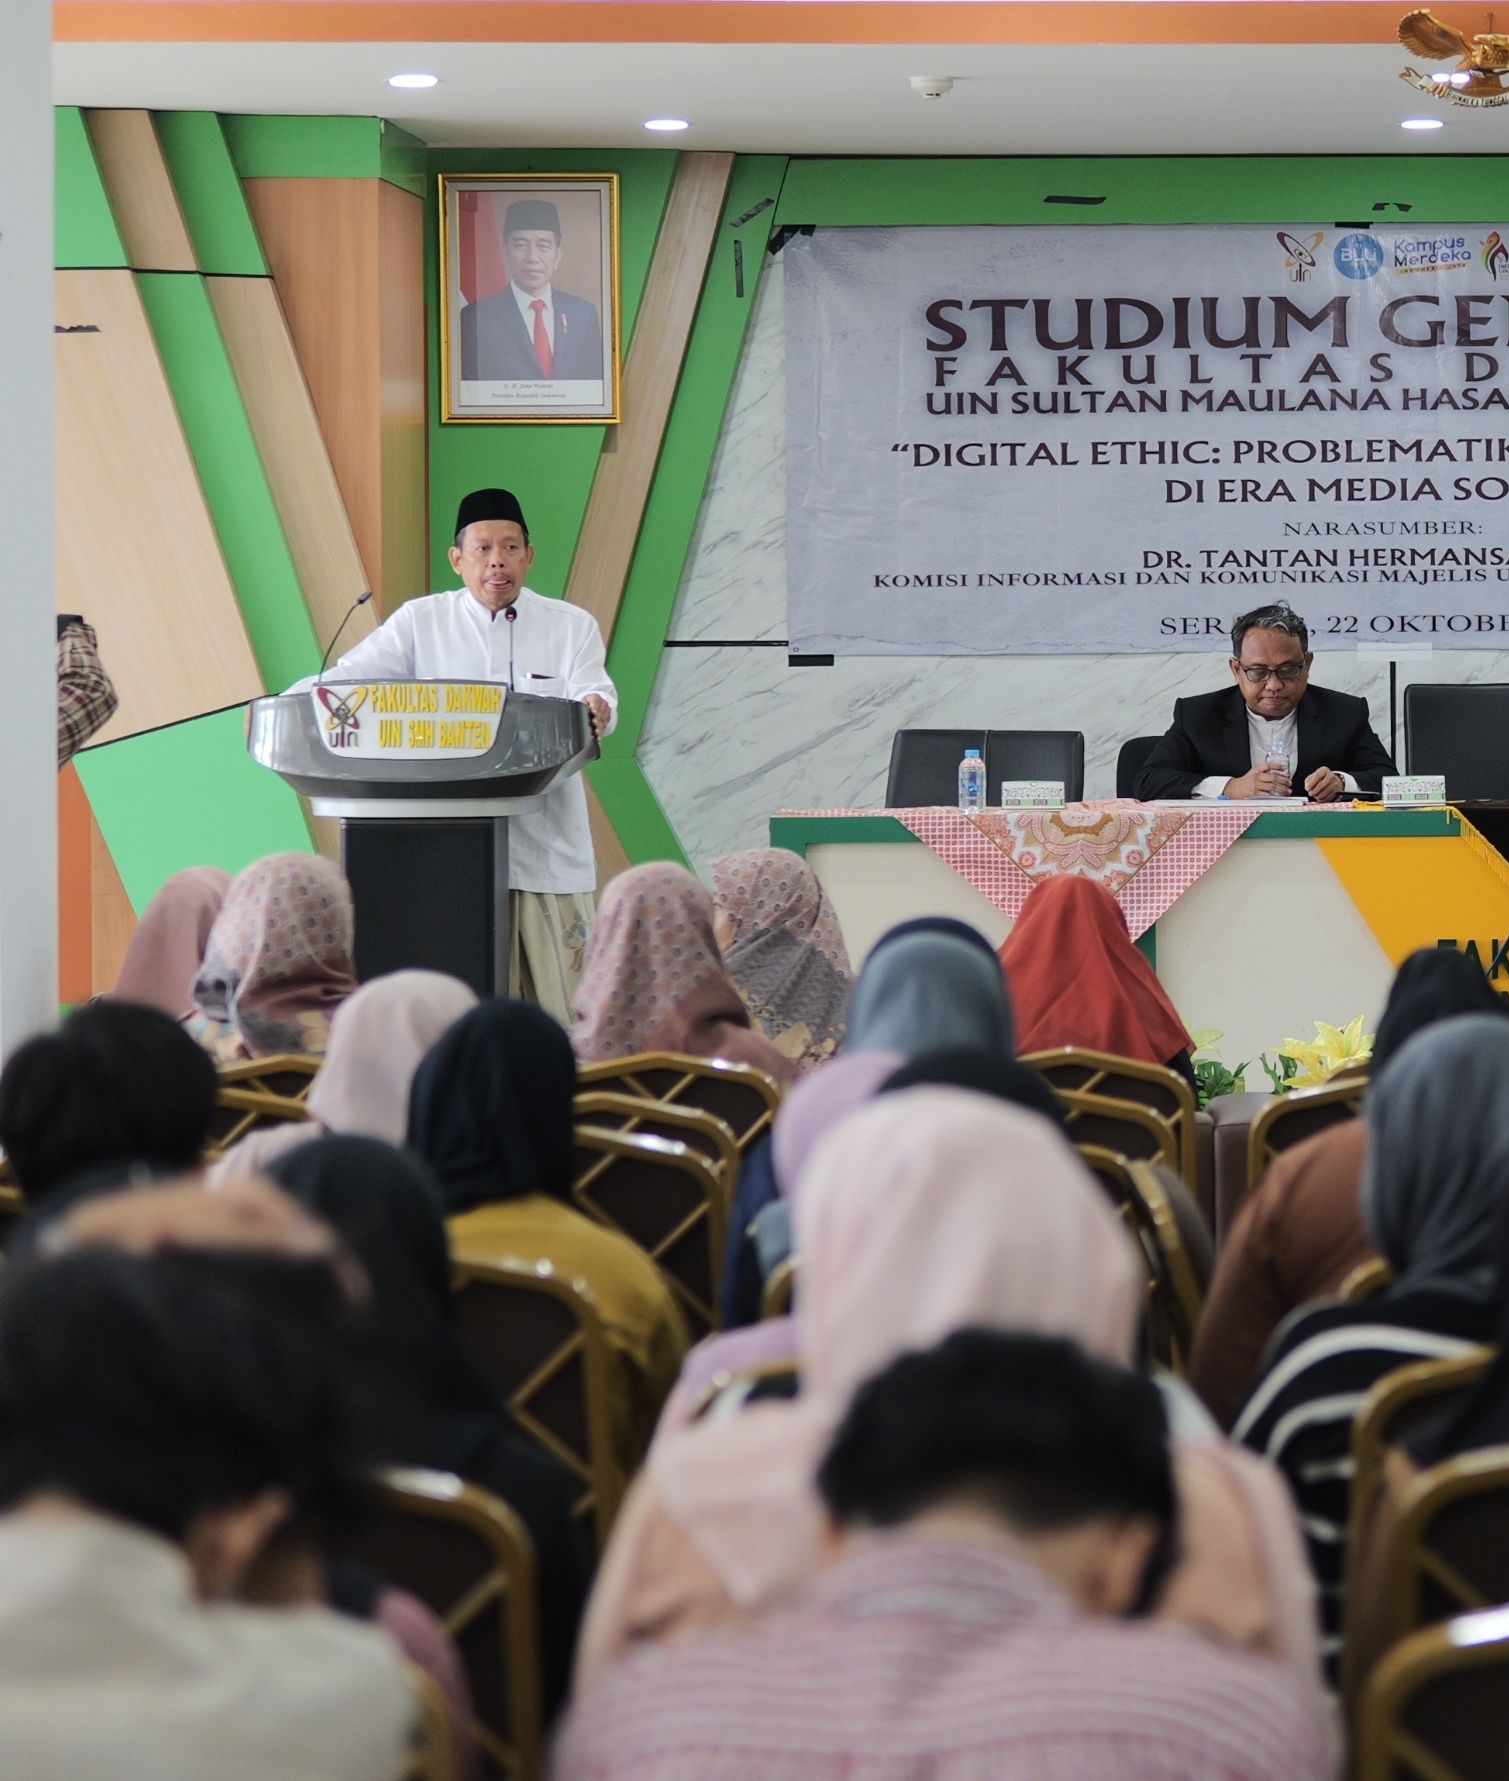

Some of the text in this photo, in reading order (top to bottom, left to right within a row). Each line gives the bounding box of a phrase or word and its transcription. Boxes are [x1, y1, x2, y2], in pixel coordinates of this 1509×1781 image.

[1393, 236, 1466, 254] Kampus
[1394, 249, 1472, 267] Merdeka
[925, 295, 1349, 353] STUDIUM
[933, 352, 1394, 387] FAKULTAS
[925, 391, 999, 416] UIN
[1011, 389, 1169, 415] SULTAN
[1179, 387, 1392, 413] MAULANA
[890, 442, 1080, 468] “DIGITAL
[1090, 440, 1222, 466] ETHIC:
[1164, 478, 1205, 504] DI
[1217, 478, 1298, 503] ERA
[1306, 477, 1444, 503] MEDIA
[1282, 519, 1484, 537] NARASUMBER:
[1142, 549, 1193, 569] DR.
[1198, 548, 1339, 569] TANTAN
[873, 573, 969, 588] KOMISI
[976, 572, 1127, 587] INFORMASI
[1135, 571, 1192, 585] DAN
[1199, 569, 1371, 585] KOMUNIKASI
[1378, 568, 1488, 586] MAJELIS
[1326, 615, 1359, 634] 22
[370, 684, 502, 714] FAKULTAS DAKWAH
[378, 719, 491, 749] UIN SMH BANTEN
